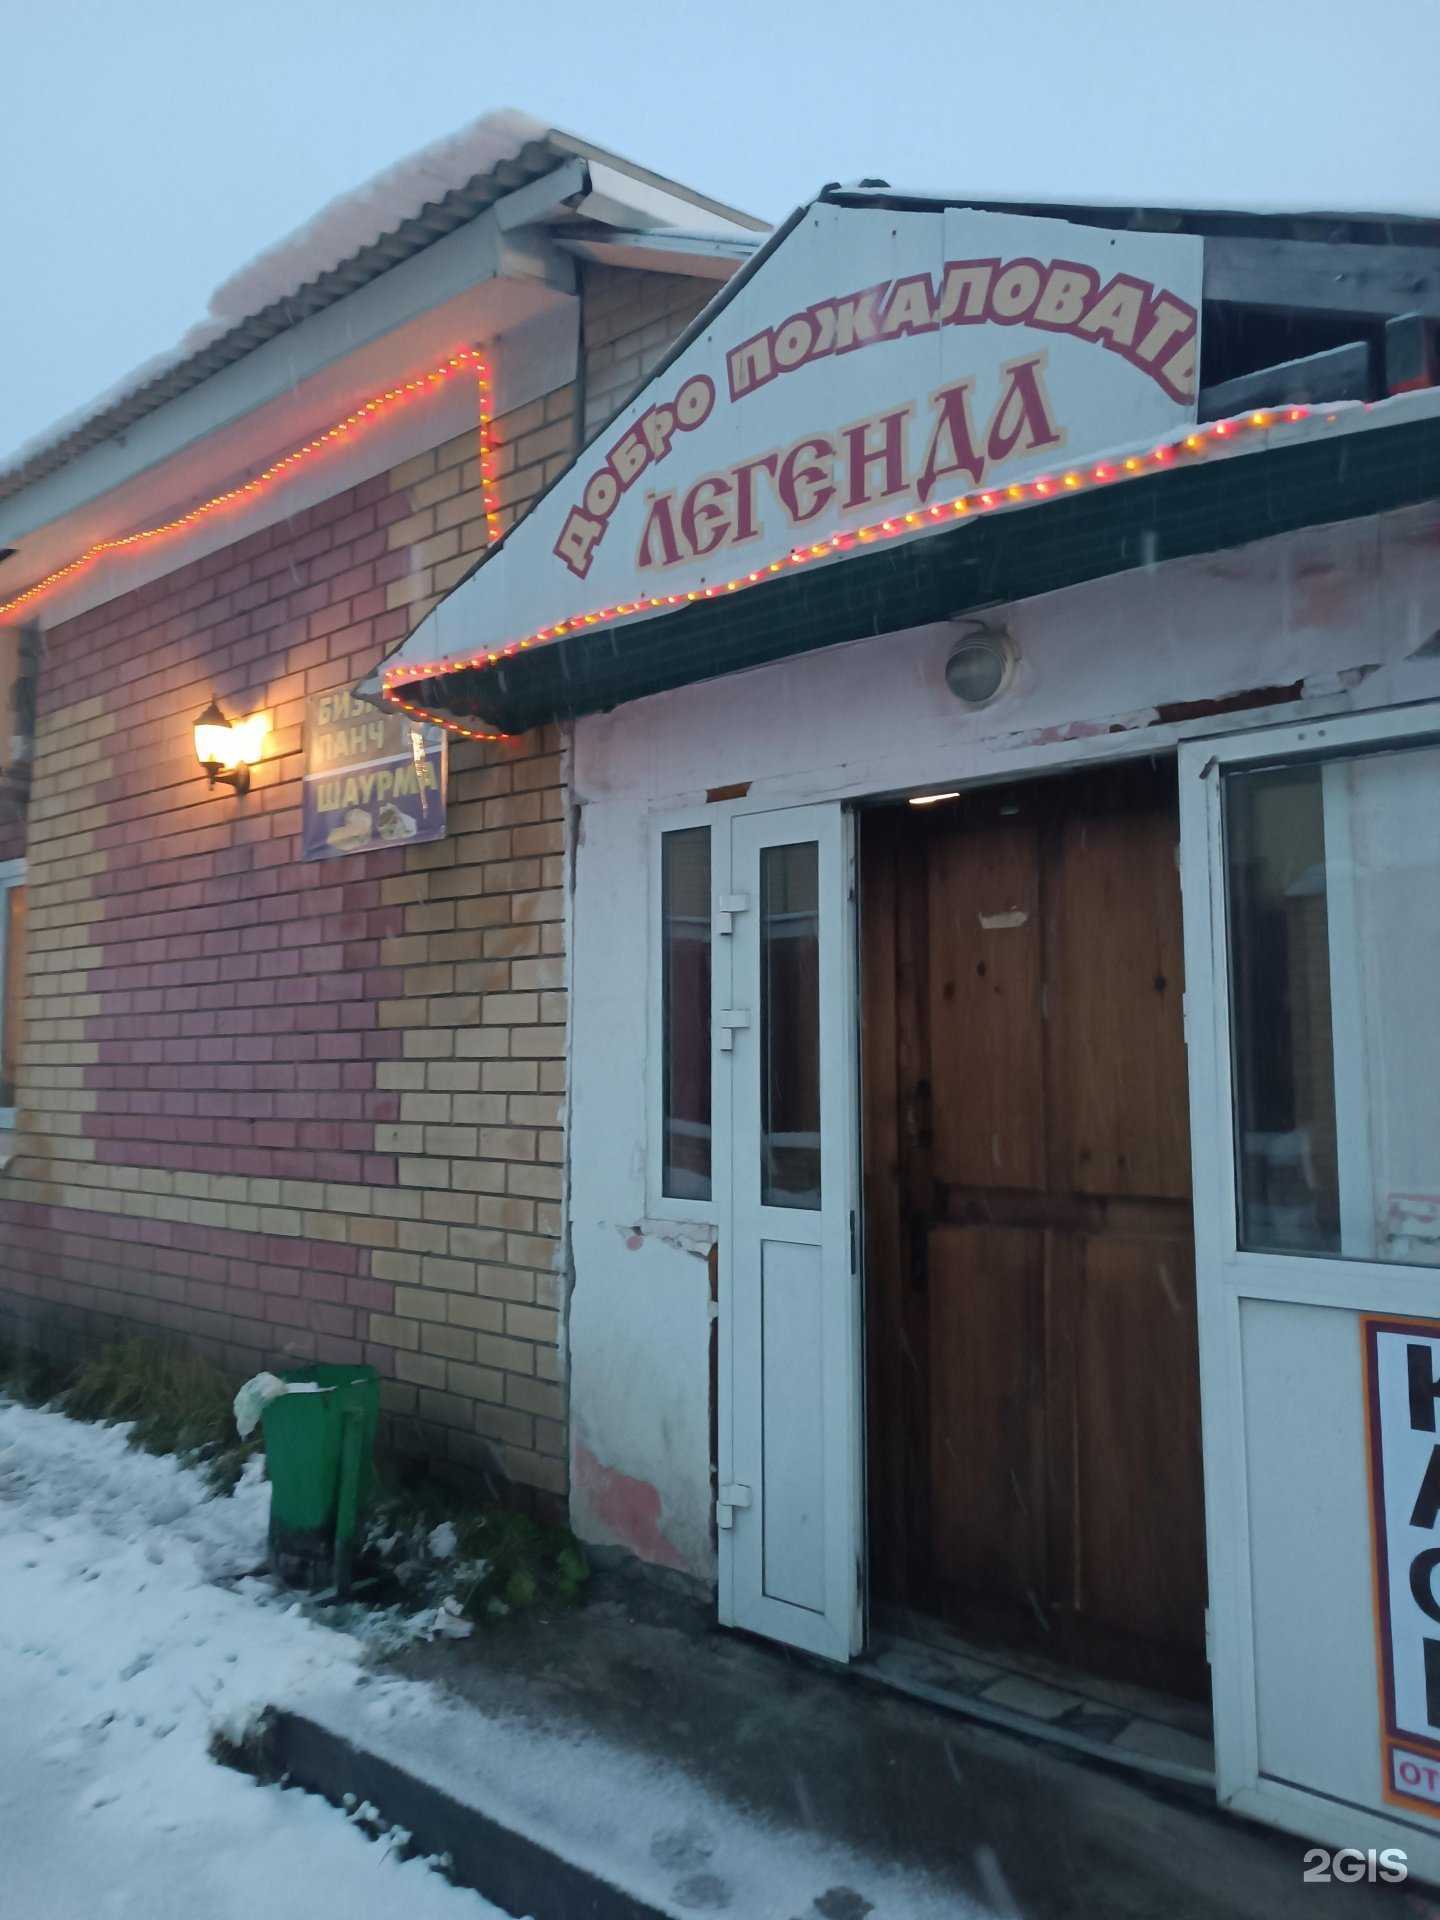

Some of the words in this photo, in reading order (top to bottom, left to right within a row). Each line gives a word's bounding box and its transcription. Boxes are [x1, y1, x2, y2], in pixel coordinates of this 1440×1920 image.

[553, 373, 716, 579] ДОБРО
[635, 348, 1066, 573] ЛЕГЕНДА
[316, 762, 438, 813] ШАУРМА
[317, 720, 385, 762] ЛАНЧ
